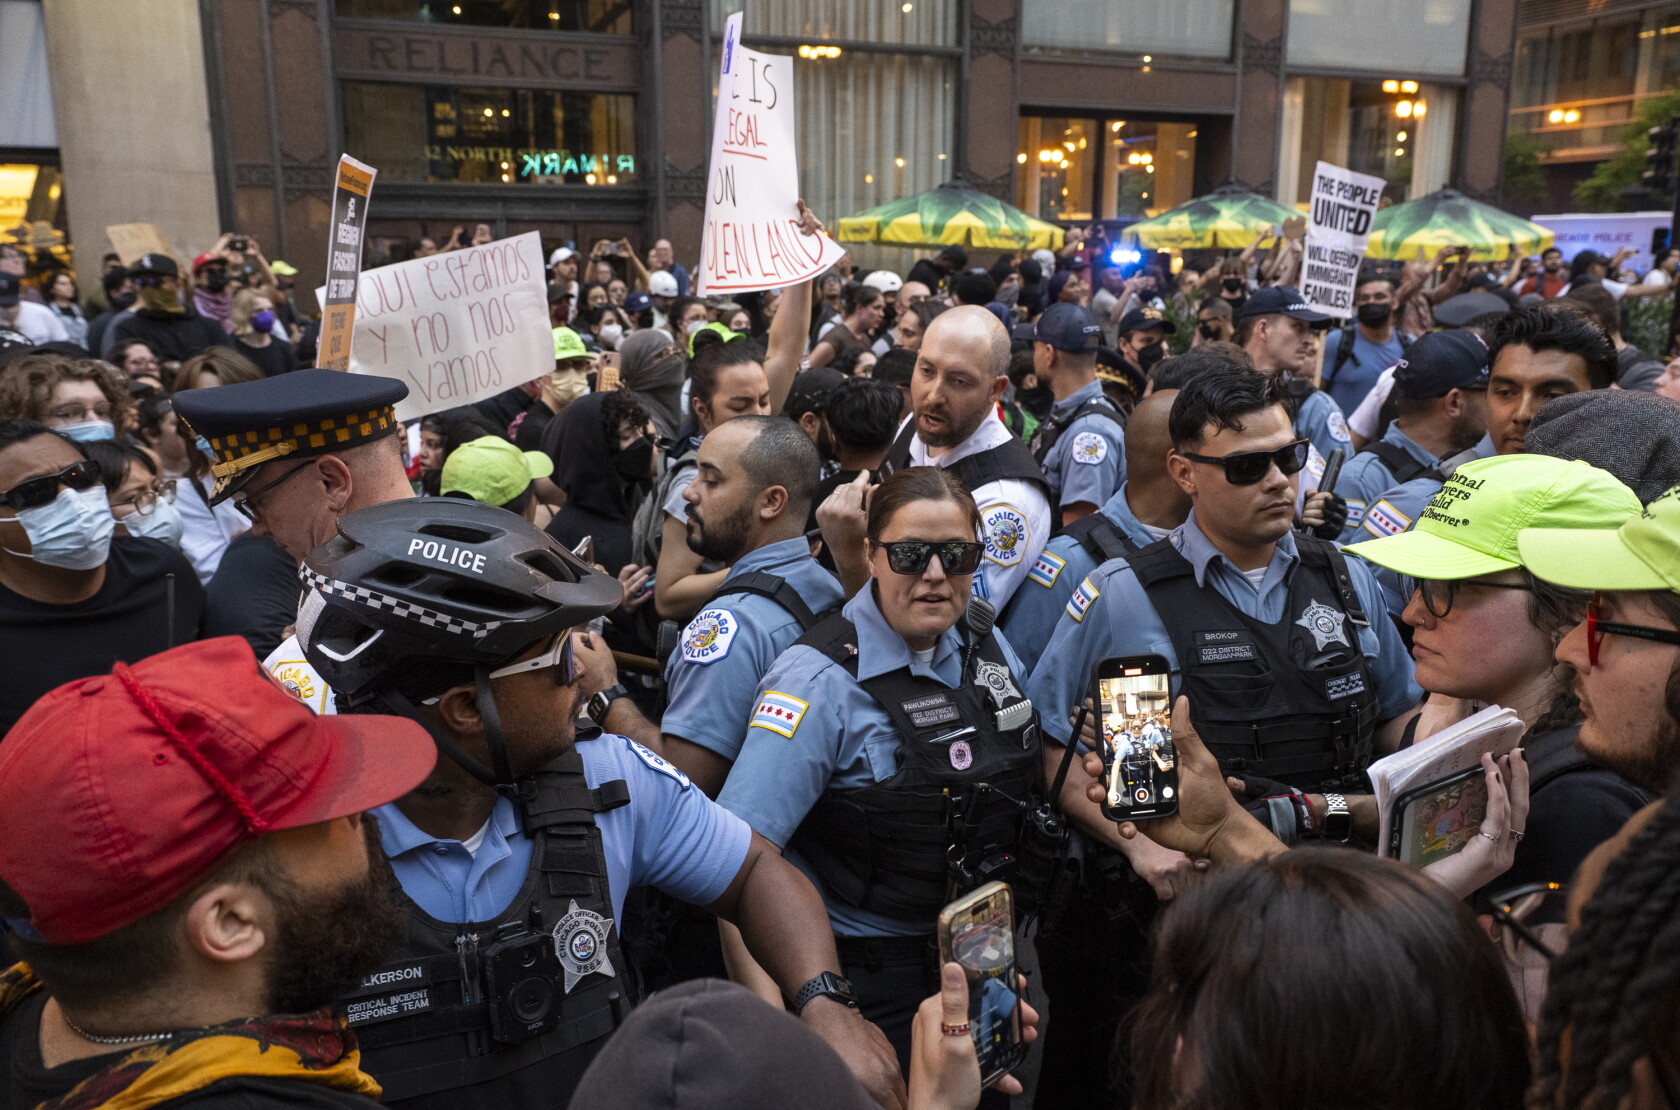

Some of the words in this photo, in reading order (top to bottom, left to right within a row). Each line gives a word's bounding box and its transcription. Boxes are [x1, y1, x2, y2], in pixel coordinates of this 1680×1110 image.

[368, 36, 612, 81] RELIANCE
[749, 57, 777, 110] IS
[724, 107, 767, 148] EGAL
[449, 147, 512, 162] NORTH
[1317, 175, 1334, 196] THE
[1336, 181, 1379, 206] PEOPLE
[1314, 198, 1371, 236] UNITED
[707, 220, 752, 280] OLEN
[752, 219, 823, 280] LAND
[1308, 245, 1328, 263] WILL
[1329, 249, 1359, 269] DEFEND
[423, 239, 531, 301] estamos
[1307, 264, 1354, 288] IMMIGRANT
[411, 311, 450, 358] no
[468, 293, 516, 343] nos
[987, 511, 1024, 541] CHICAGO
[407, 538, 487, 574] POLICE
[984, 536, 1017, 559] POLICE
[688, 611, 729, 635] CHICAGO
[1205, 632, 1238, 640] BROKOP
[684, 640, 719, 658] POLICE
[1202, 653, 1233, 661] MORGAN
[1234, 651, 1253, 659] PARK
[1218, 645, 1251, 654] DISTRICT
[924, 706, 953, 717] DISTRICT
[555, 913, 575, 934] POLICE
[575, 911, 600, 921] OFFICER
[559, 920, 580, 958] CHICAGO
[584, 919, 605, 945] POLICE
[361, 966, 422, 988] LKERSON
[347, 998, 388, 1013] CRITICAL
[390, 989, 428, 1005] INCIDENT
[348, 1004, 399, 1023] RESPONSE
[401, 997, 429, 1012] TEAM
[527, 1020, 544, 1031] AXON
